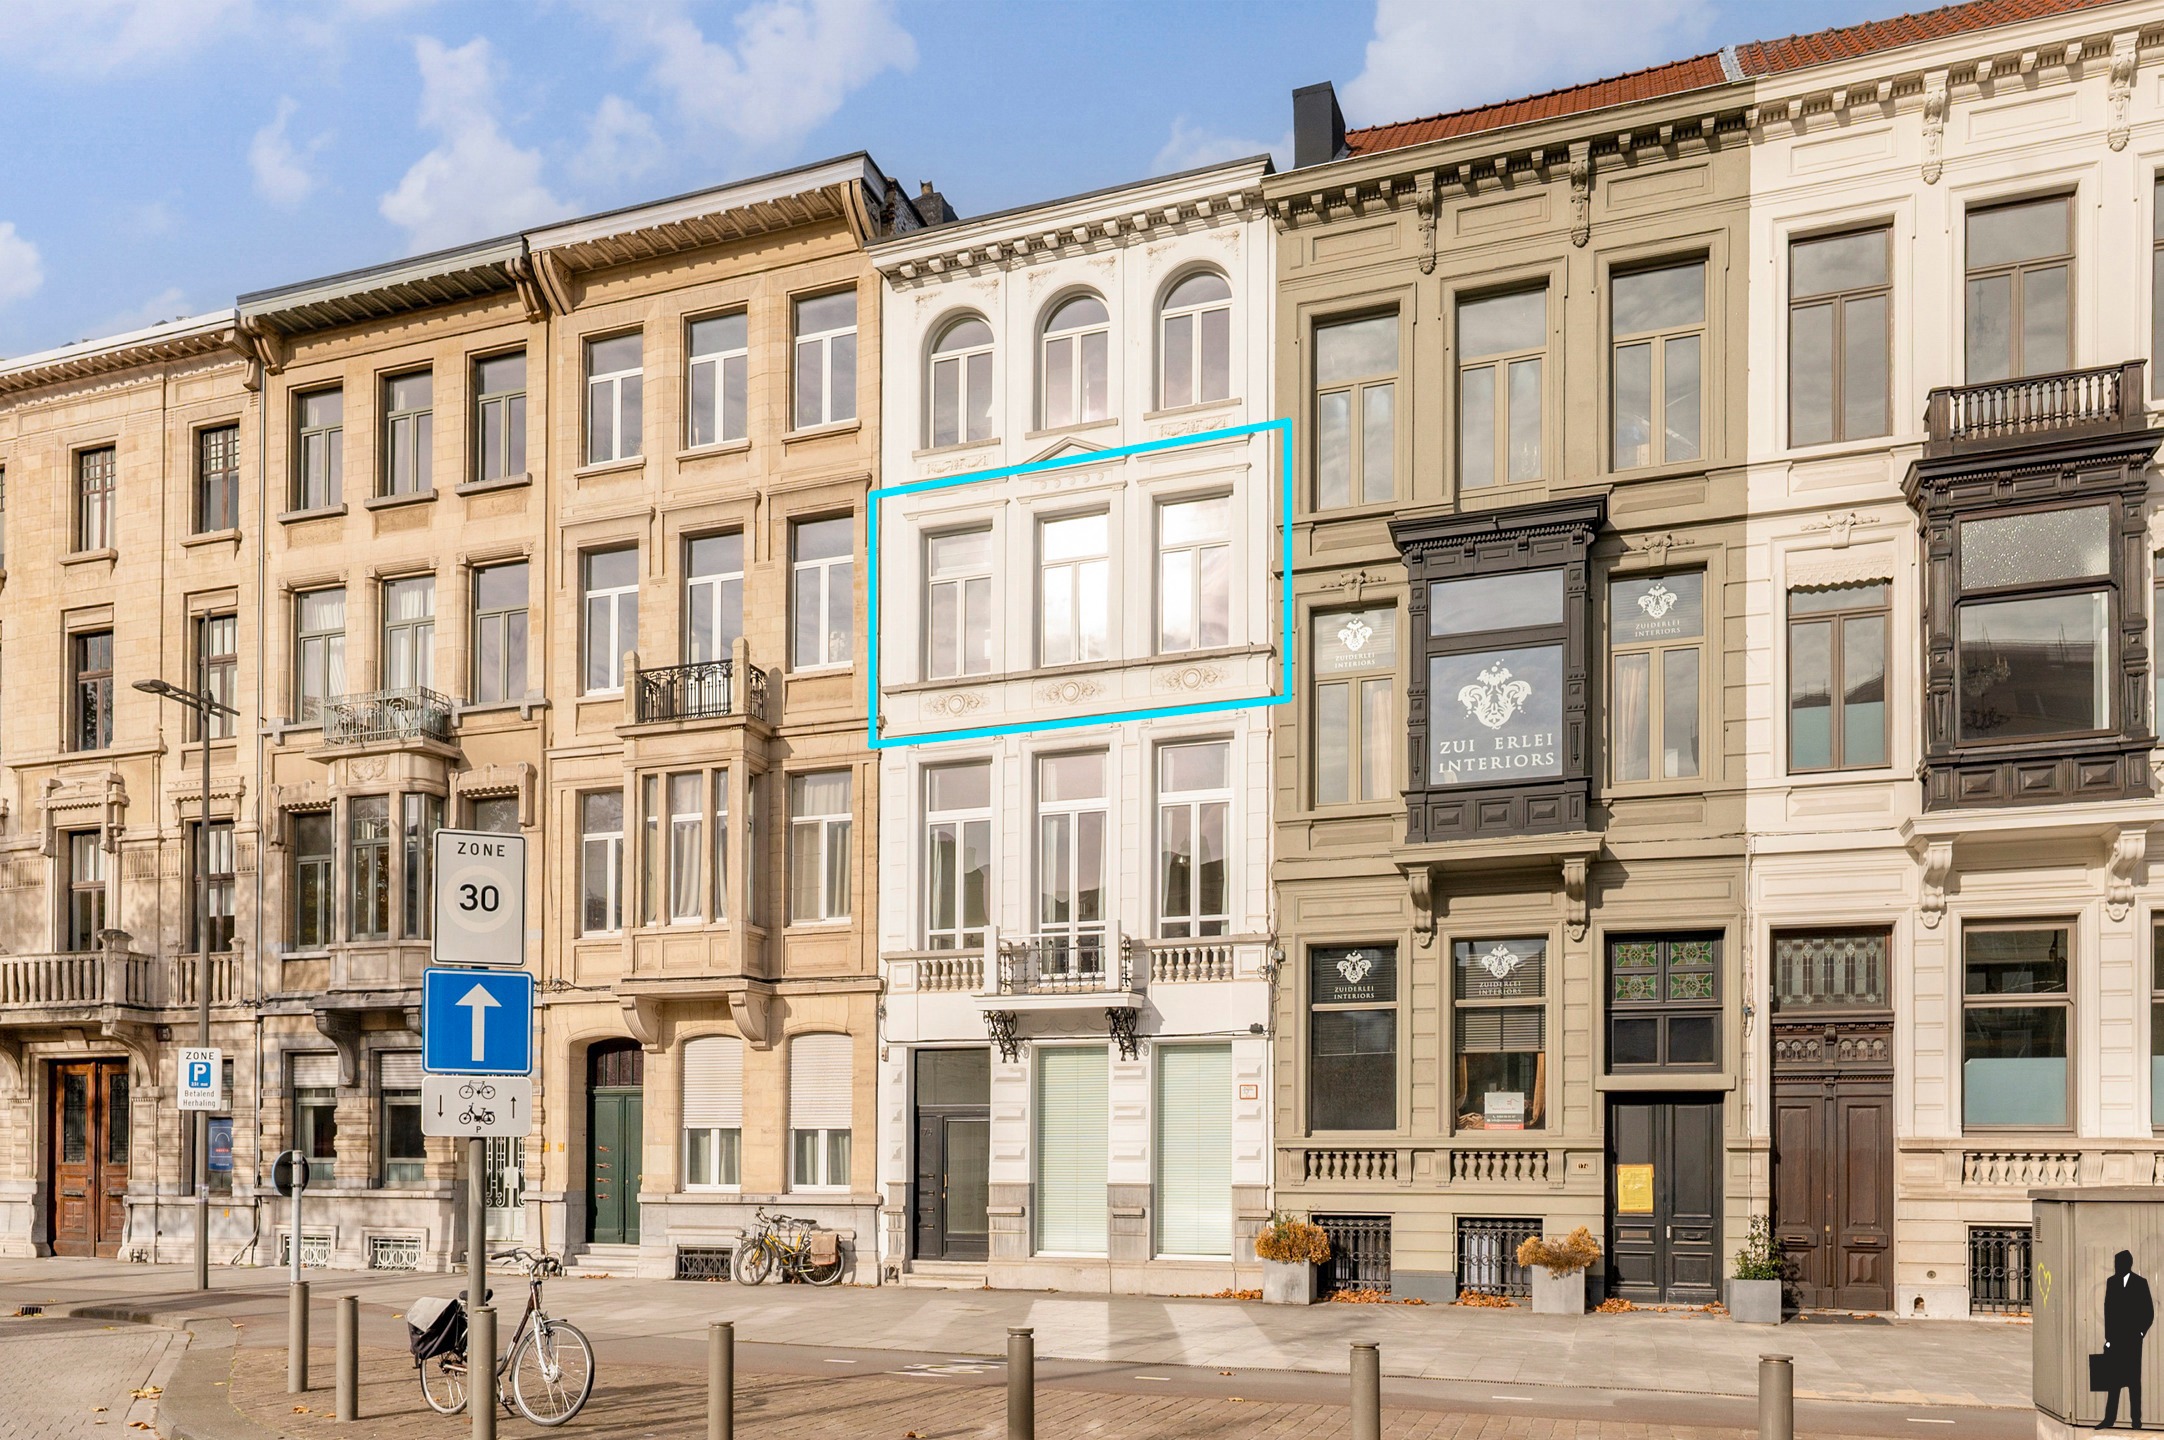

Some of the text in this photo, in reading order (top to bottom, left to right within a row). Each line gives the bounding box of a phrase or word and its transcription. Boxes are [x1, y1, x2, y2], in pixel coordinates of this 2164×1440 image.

[1635, 619, 1680, 630] ZUIDERLEI
[1634, 627, 1681, 638] INTERIORS
[1335, 652, 1375, 661] ZUIDERLEI
[1334, 659, 1376, 669] INTERIORS
[1439, 733, 1553, 755] ZUI ERLEI
[1438, 752, 1554, 773] INTERIORS
[457, 842, 506, 857] ZONE
[459, 883, 500, 912] 30
[1479, 980, 1521, 988] ZUIDERLEI
[1334, 985, 1374, 993] ZUIDERLEI
[1478, 988, 1522, 996] INTERIORS
[1333, 992, 1375, 1000] INTERIORS
[185, 1051, 215, 1060] ZONE
[193, 1063, 207, 1082] P
[184, 1090, 215, 1098] Betalend
[183, 1099, 216, 1108] Herhaling
[475, 1125, 482, 1133] P
